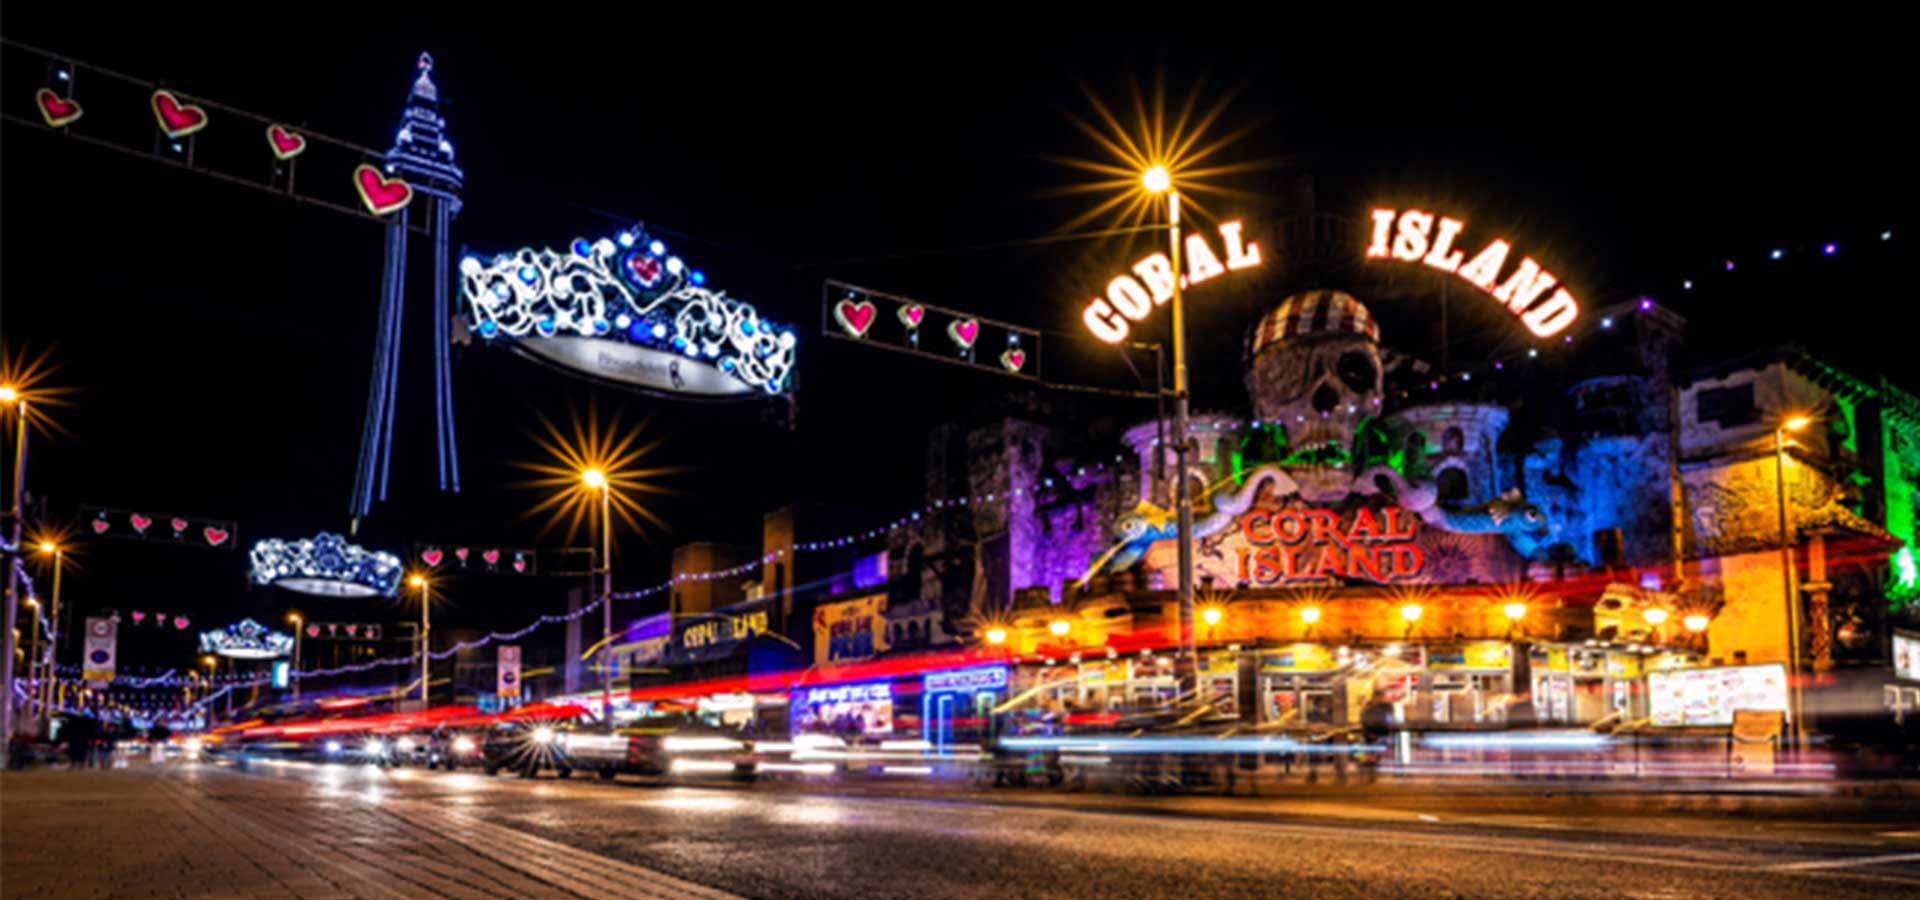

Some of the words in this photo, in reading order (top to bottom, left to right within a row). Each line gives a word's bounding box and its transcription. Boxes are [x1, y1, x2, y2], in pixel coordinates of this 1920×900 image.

[1083, 219, 1263, 344] CORAL
[1367, 207, 1580, 339] ISLAND
[1241, 506, 1417, 548] CORAL
[1235, 543, 1425, 585] ISLAND
